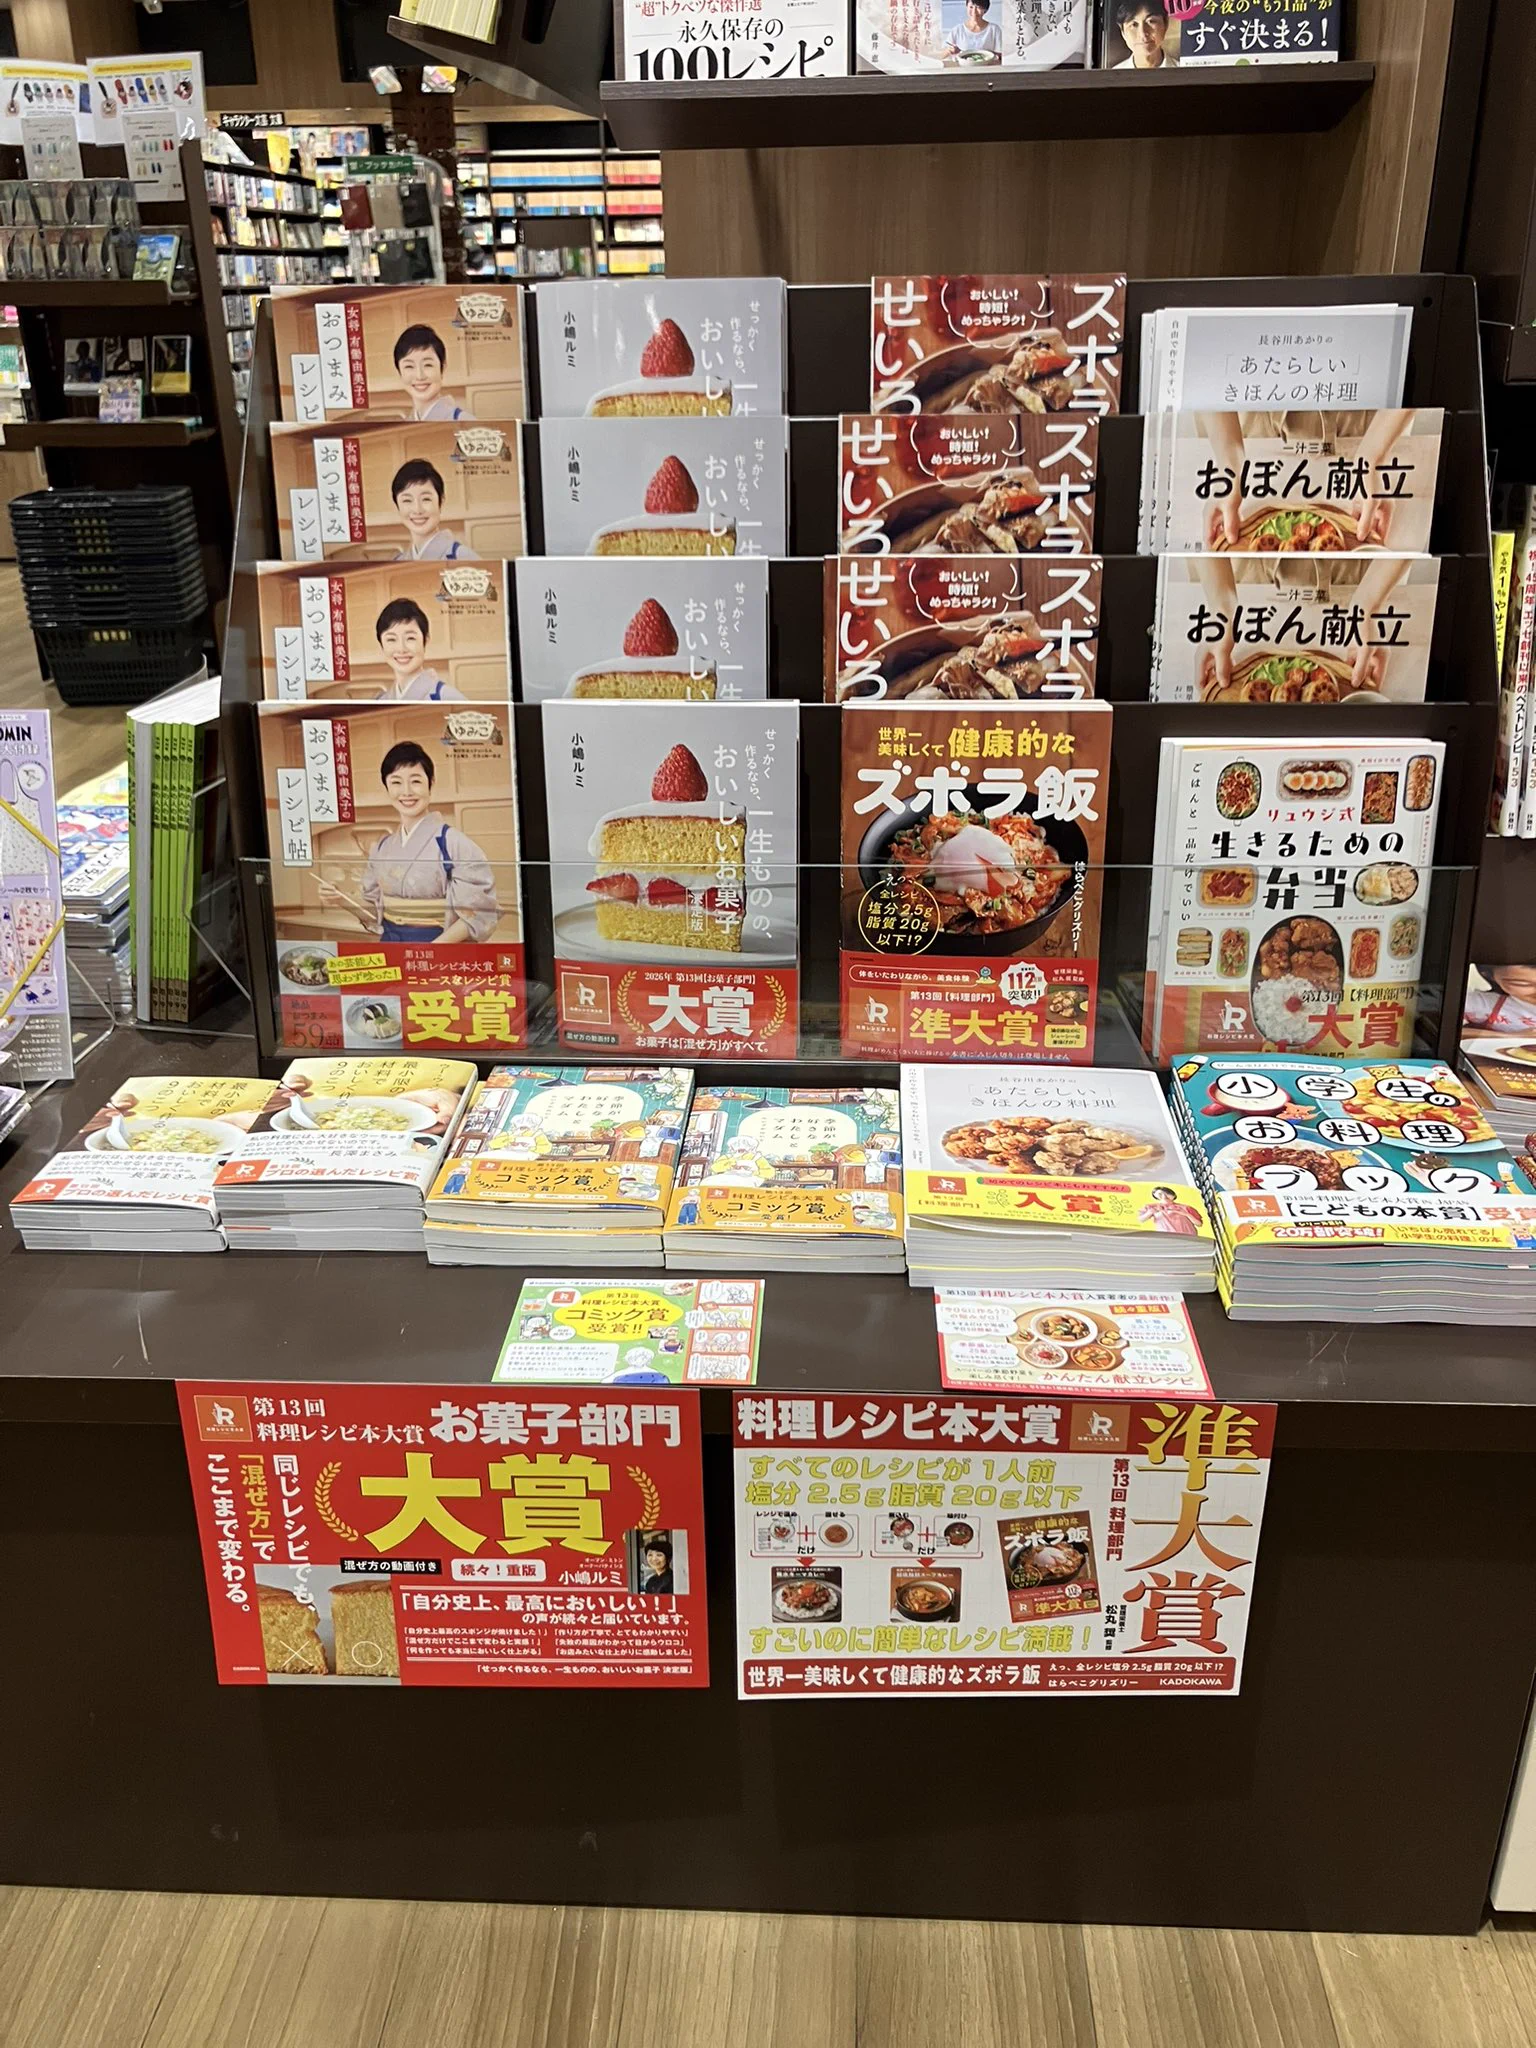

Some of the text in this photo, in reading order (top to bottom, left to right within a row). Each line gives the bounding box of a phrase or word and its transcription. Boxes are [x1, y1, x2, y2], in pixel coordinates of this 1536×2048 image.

[677, 17, 784, 43] 永久保存の
[1186, 17, 1329, 53] すぐ決まる!
[633, 35, 834, 80] 100レシピ
[969, 289, 1019, 301] おいしい!
[978, 302, 1009, 314] 時短!
[747, 301, 760, 352] せっかく
[961, 315, 1026, 327] めっちゃラク!
[563, 310, 577, 368] 小嶋ルミ
[873, 280, 928, 415] せいろ
[1062, 276, 1127, 416] ズボラ
[322, 311, 348, 402] おつまみ
[350, 335, 366, 405] 有働由美子の
[299, 361, 320, 420] レシピ
[1224, 381, 1358, 402] きほんの料理
[939, 427, 990, 440] おいしい!
[949, 441, 980, 453] 時短!
[930, 453, 997, 466] めっちゃラク!
[1282, 442, 1335, 454] 一汁三菜
[567, 446, 580, 502] 小嶋ルミ
[752, 438, 766, 490] せっかく
[320, 447, 346, 536] おつまみ
[841, 419, 897, 555] せいろ
[1034, 416, 1100, 555] ズボラ
[1195, 456, 1416, 500] おぼん献立
[348, 469, 364, 539] 有働由美子の
[298, 496, 317, 554] レシピ
[938, 570, 990, 583] おいしい!
[948, 583, 979, 596] 時短!
[732, 581, 745, 633] せっかく
[929, 596, 998, 609] めっちゃラク!
[1275, 589, 1328, 602] 一汁三菜
[544, 587, 558, 644] 小嶋ルミ
[1186, 604, 1412, 648] おぼん献立
[305, 584, 329, 675] おつまみ
[838, 560, 896, 701] せいろ
[1035, 561, 1103, 700] ズボラ
[333, 609, 347, 678] 有働由美子の
[281, 633, 301, 694] レシピ
[878, 727, 922, 740] 世界一
[878, 725, 1075, 759] 美味しくて 健康的な
[308, 728, 335, 816] おつまみ
[571, 732, 585, 788] 小嶋ルミ
[744, 728, 777, 801] せっかく 作るなら、
[336, 751, 352, 820] 有働由美子の
[853, 760, 1099, 823] ズボラ飯
[284, 776, 308, 860] レシピ帖
[1266, 806, 1355, 823] リュウジ式
[713, 744, 740, 934] おいしいお菓子
[1180, 762, 1203, 922] ごはんと一品だけでいい
[1210, 830, 1405, 859] 生きるための
[748, 811, 774, 939] 一生ものの、
[1262, 866, 1348, 911] 弁当
[879, 889, 919, 900] 全レシピ
[867, 902, 934, 918] 塩分 2.5g
[866, 917, 930, 933] 脂質 20g
[876, 934, 923, 947] 以下!?
[405, 961, 495, 973] 料理レシピ本大賞
[407, 974, 512, 987] ニュースなレシピ賞
[644, 972, 672, 982] 2026年
[648, 984, 755, 1038] 大賞
[910, 991, 996, 1004] 第13回【料理部門】
[407, 989, 520, 1044] 受賞
[909, 1007, 1040, 1048] 準大賞
[1306, 1001, 1406, 1050] 大賞
[635, 1037, 769, 1053] お菓子は「混ぜ方」がすべて。
[970, 1097, 1119, 1109] きほんの料理
[1226, 1076, 1456, 1107] 小学生の
[1247, 1121, 1460, 1144] お料理
[265, 1167, 421, 1181] プロの選んだレシピ賞
[493, 1174, 594, 1187] コミック賞
[1264, 1167, 1482, 1191] ブック
[61, 1187, 212, 1206] プロの選んだレシピ賞
[726, 1202, 827, 1215] コミック賞
[1014, 1191, 1106, 1215] 入賞
[1285, 1203, 1481, 1221] 【こどもの本賞】
[1271, 1226, 1385, 1239] 20万部突破!
[1392, 1225, 1494, 1237] いちばん売れてる
[581, 1299, 661, 1307] 料理レシピ本大賞
[979, 1289, 1084, 1300] 料理レシピ本大賞
[565, 1307, 670, 1323] コミック賞
[1042, 1370, 1197, 1387] かんたん献立レシピ
[252, 1396, 326, 1418] 第13回
[257, 1400, 682, 1448] 料理レシピ本大賞 お菓子部門
[737, 1397, 1062, 1446] 料理レシピ本大賞
[748, 1455, 1057, 1484] すべてのレシピが 1人前
[237, 1453, 277, 1562] 「混ぜ方」で
[359, 1451, 614, 1556] 大賞
[745, 1480, 800, 1506] 塩分
[951, 1485, 1083, 1510] 20g以下
[1105, 1458, 1130, 1562] 第13回 料理部門
[207, 1453, 251, 1613] ここまで変わる。
[272, 1453, 317, 1613] 同じレシピでも、
[1003, 1526, 1091, 1551] ズボラ飯
[1120, 1402, 1262, 1655] 準大賞
[797, 1546, 816, 1555] だけ
[917, 1546, 936, 1556] だけ
[343, 1559, 438, 1573] 混ぜ方の動画付き
[459, 1562, 538, 1578] 続々!重版
[558, 1570, 623, 1586] 小嶋ルミ
[401, 1593, 679, 1613] 「自分史上、最高においしい!」
[1034, 1598, 1082, 1614] 準大賞
[522, 1613, 690, 1626] の声が続々と届いています。
[749, 1625, 1092, 1654] すごいのに簡単なレシピ満載!
[748, 1663, 1041, 1688] 世界一美味しくて健康的なズボラ飯
[1132, 1663, 1153, 1673] 2.5g
[1173, 1663, 1193, 1673] 20g
[1159, 1677, 1223, 1686] KADOKAWA
[1048, 1678, 1139, 1688] はらぺこグリズリー
